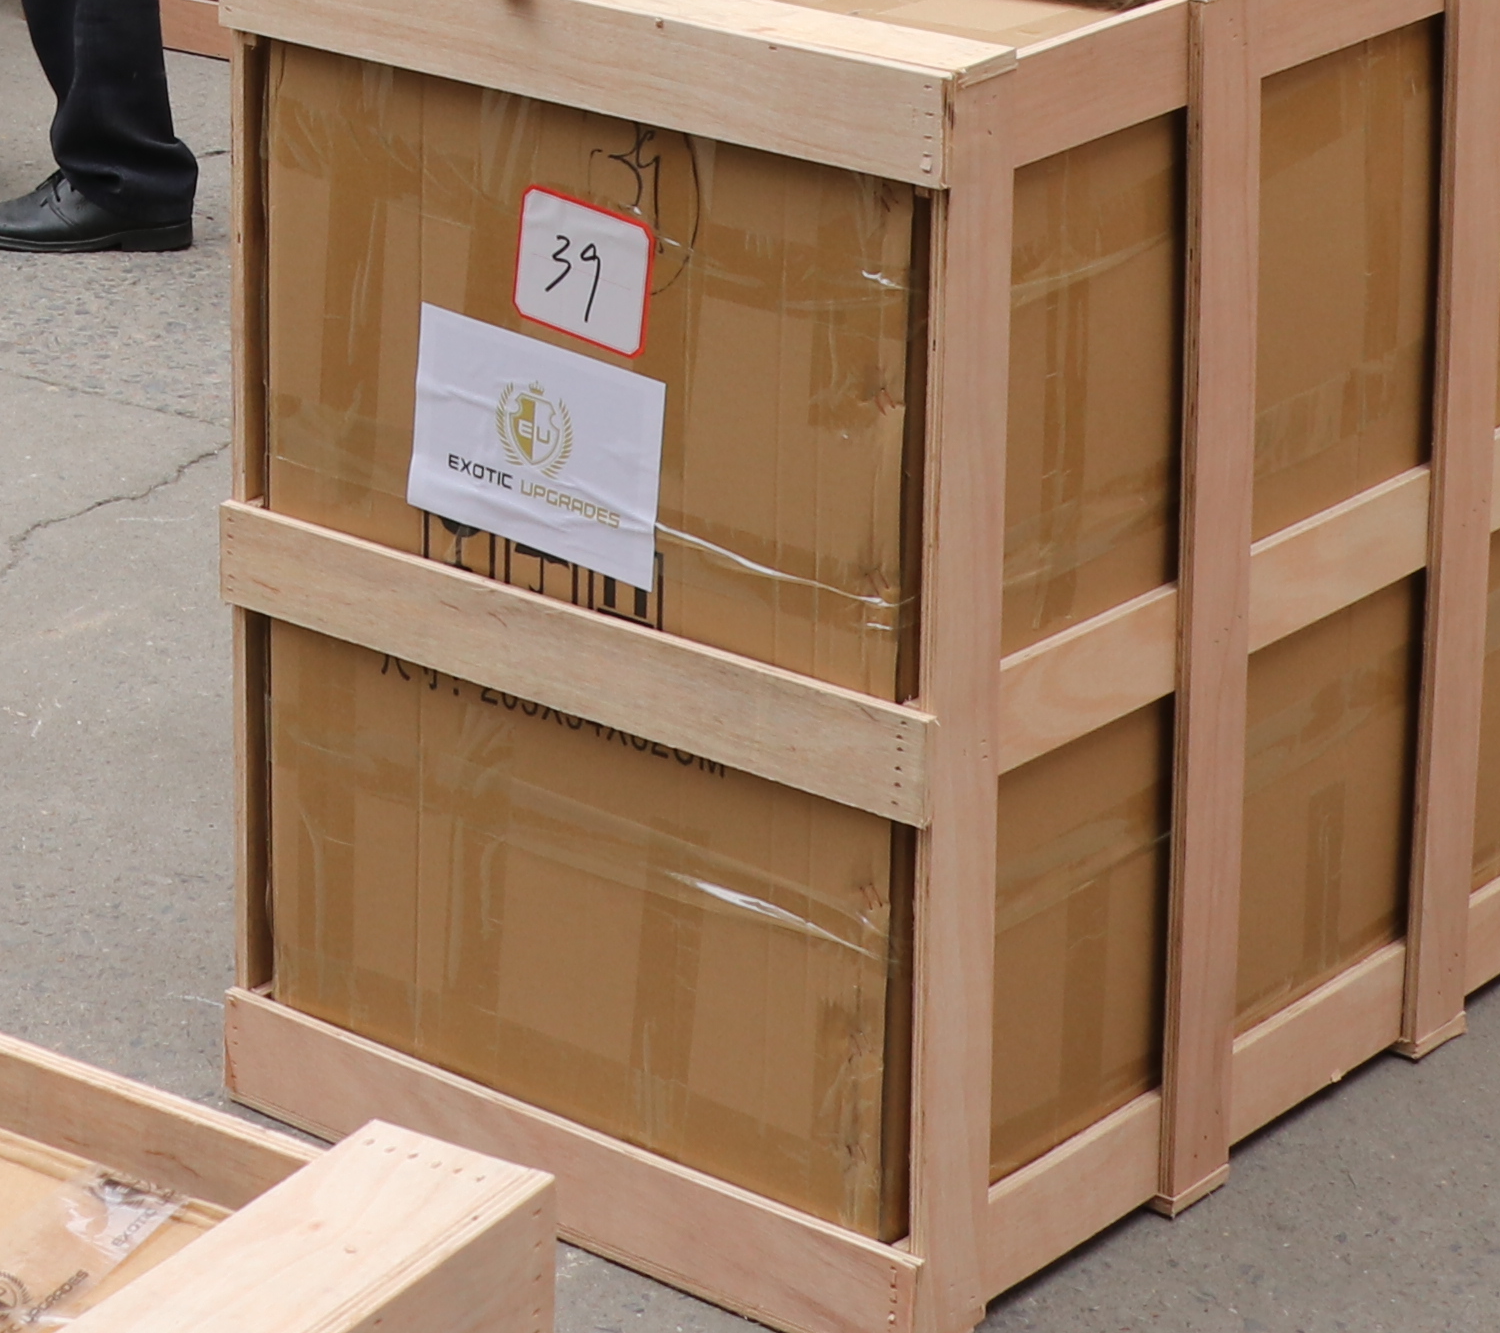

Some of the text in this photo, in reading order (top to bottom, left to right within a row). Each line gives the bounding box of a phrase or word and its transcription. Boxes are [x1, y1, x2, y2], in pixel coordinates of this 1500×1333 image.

[545, 235, 601, 323] 39
[448, 452, 621, 529] EXOTIC UPGRADES
[110, 1207, 158, 1248] EXOTIC
[23, 1268, 89, 1324] UPGRADES
